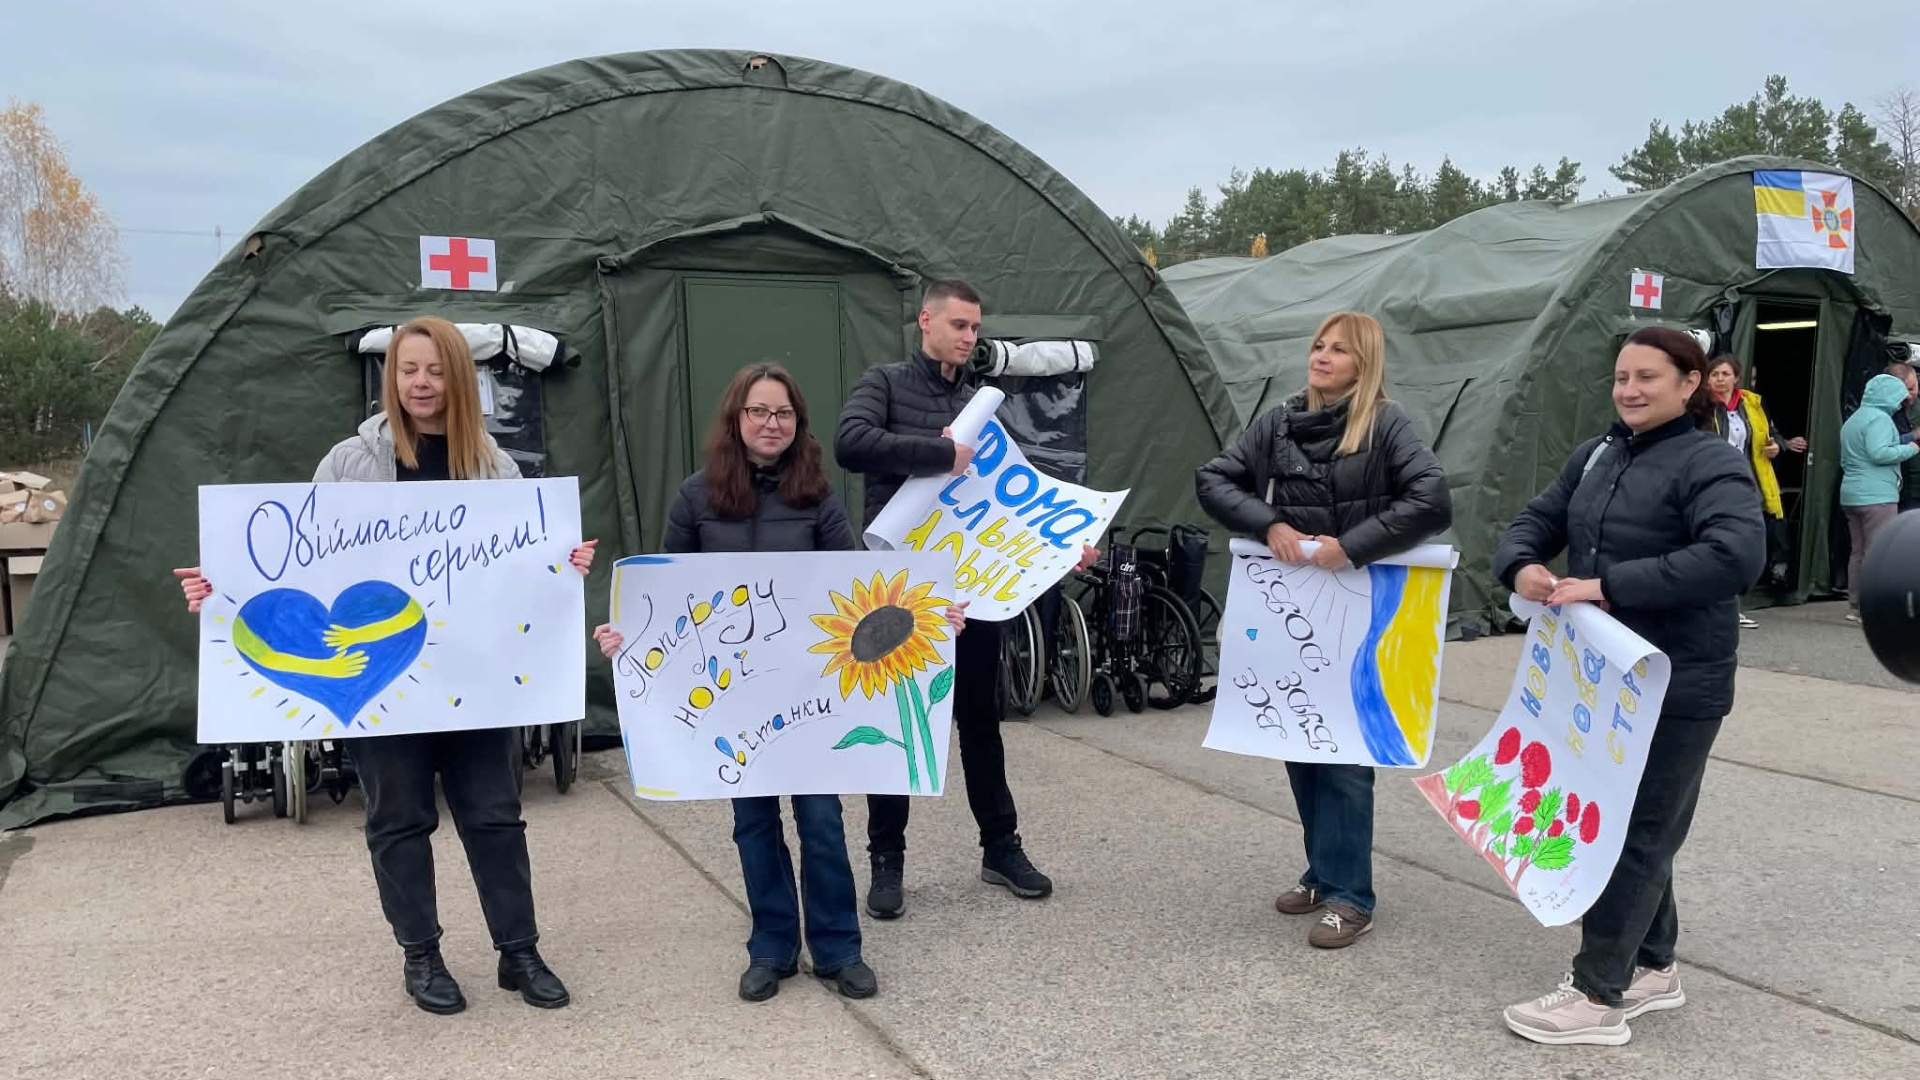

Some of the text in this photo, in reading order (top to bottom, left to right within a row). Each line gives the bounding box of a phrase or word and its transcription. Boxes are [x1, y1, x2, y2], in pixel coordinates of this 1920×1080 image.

[246, 484, 467, 582] Обіймаємо
[408, 487, 548, 606] серцем!
[617, 577, 787, 698] Попереду
[1237, 554, 1331, 673] ДОБР
[674, 649, 755, 729] нові
[1233, 667, 1288, 740] ВСЕ
[1275, 671, 1339, 754] БУДЕ
[717, 697, 832, 785] світанки
